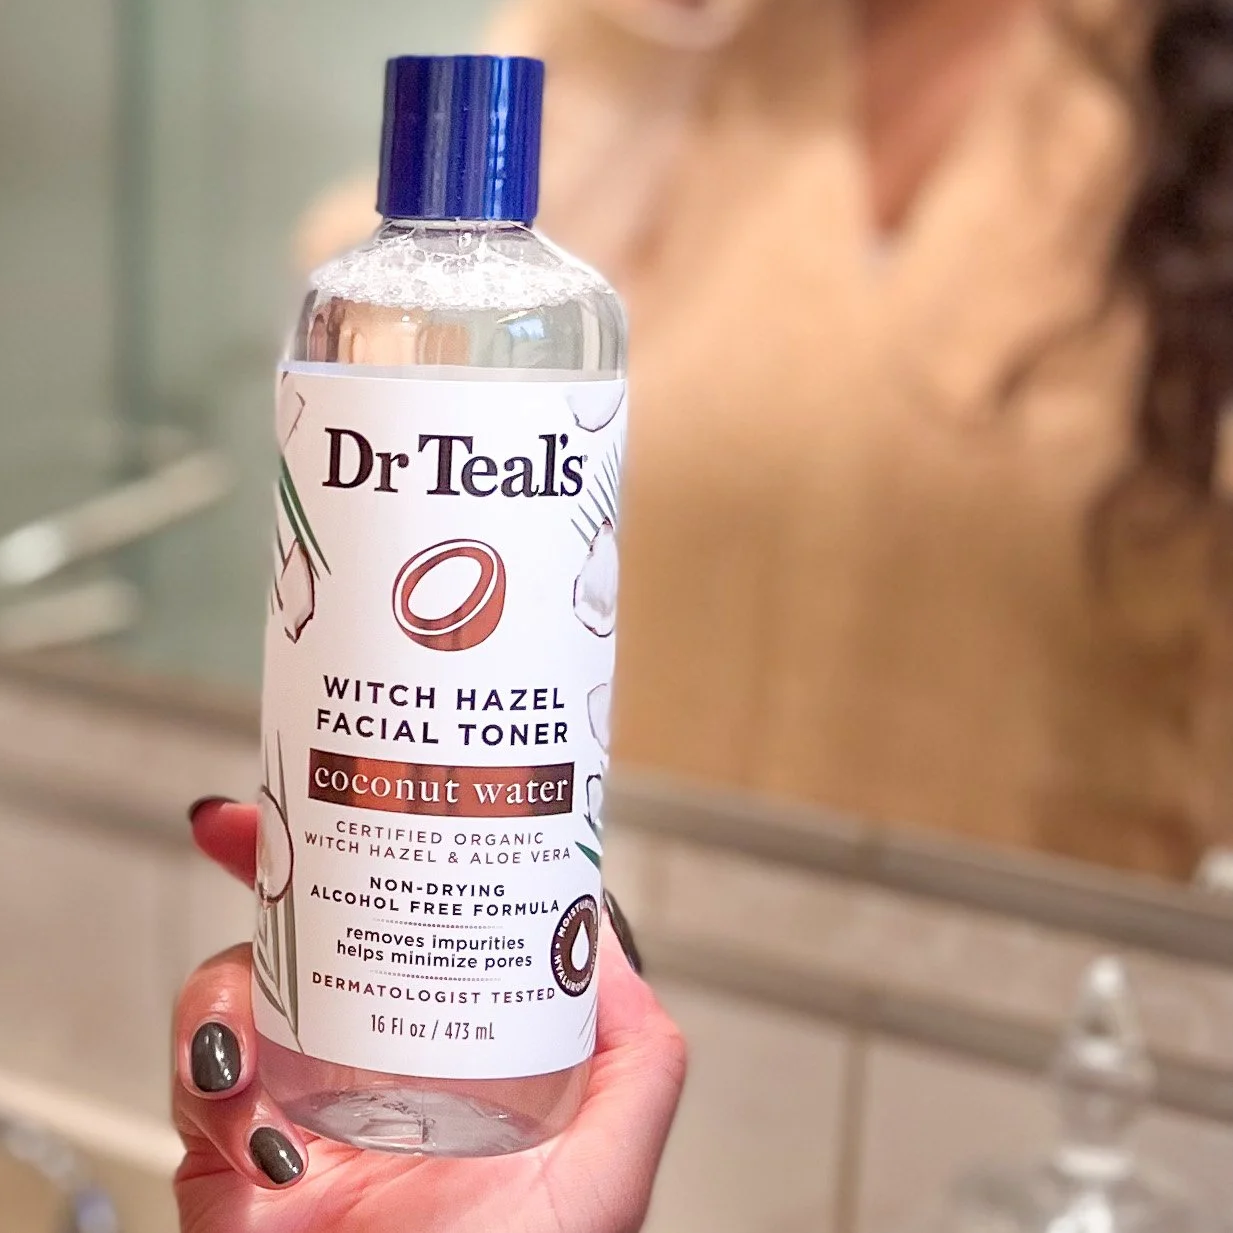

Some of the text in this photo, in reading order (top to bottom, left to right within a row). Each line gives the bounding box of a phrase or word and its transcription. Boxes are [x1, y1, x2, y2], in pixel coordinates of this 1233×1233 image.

[322, 426, 584, 498] Dr Teal's
[322, 674, 566, 712] WITCH HAZEL
[316, 709, 569, 746] FACIAL TONER
[313, 766, 570, 805] coconut water
[304, 831, 571, 866] WITCH HAZEL & ALOE VERA
[335, 820, 545, 846] CERTIFIED ORGANIC
[310, 884, 560, 917] ALCOHOL FREE FORMULA
[369, 876, 506, 898] NON-DRYING
[336, 939, 533, 972] helps minimize pores
[346, 926, 525, 952] removes impurities
[311, 971, 556, 1005] DERMATOLOGIST TESTED
[370, 1014, 386, 1034] 16
[409, 1022, 427, 1037] oz
[431, 1020, 439, 1041] /
[444, 1022, 470, 1040] 473
[476, 1022, 495, 1041] mL
